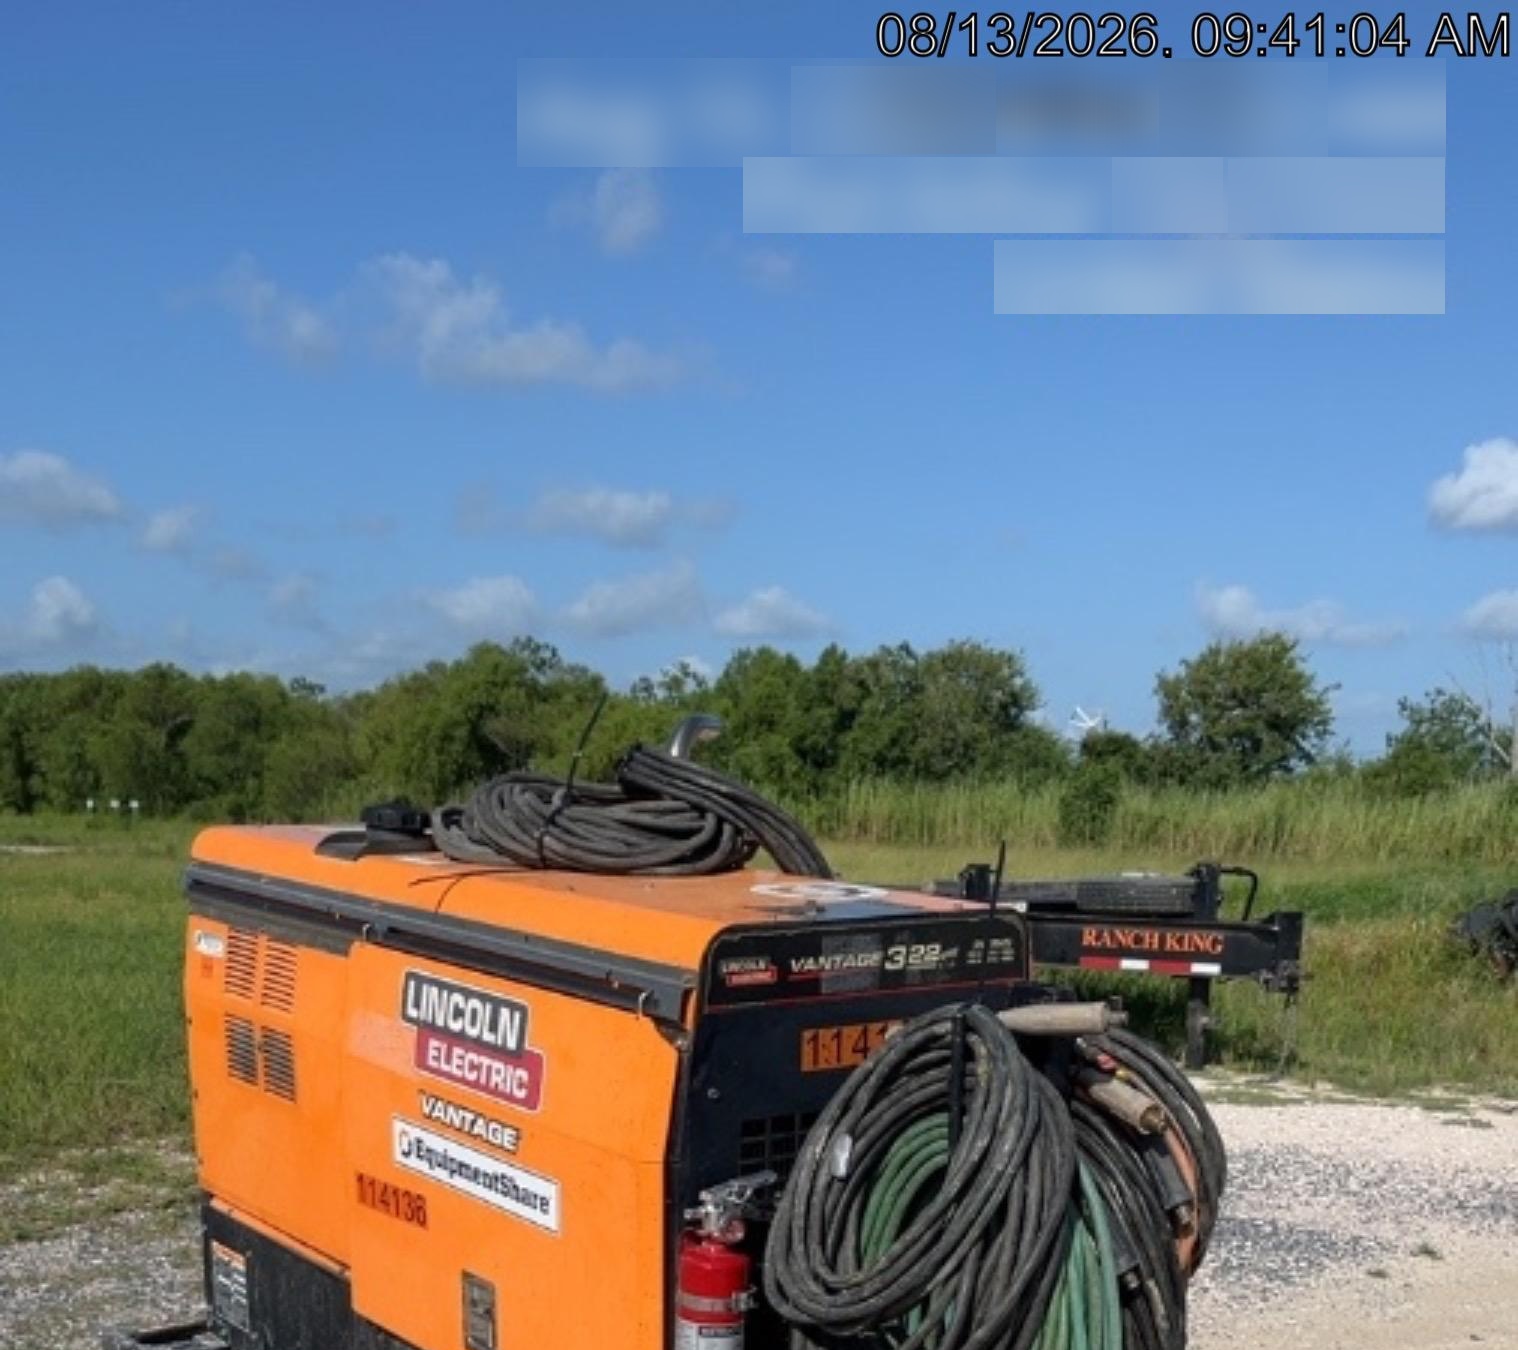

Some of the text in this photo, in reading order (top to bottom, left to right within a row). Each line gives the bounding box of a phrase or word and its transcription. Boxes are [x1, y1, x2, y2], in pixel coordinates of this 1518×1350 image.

[791, 952, 882, 972] VANTAGE
[1082, 927, 1224, 954] RANCH KING
[406, 980, 521, 1051] LINCOLN
[427, 1037, 530, 1099] ELECTRIC
[420, 1093, 522, 1153] VANTAGE
[356, 1172, 427, 1228] 114136
[414, 1136, 550, 1215] EquipmentShare
